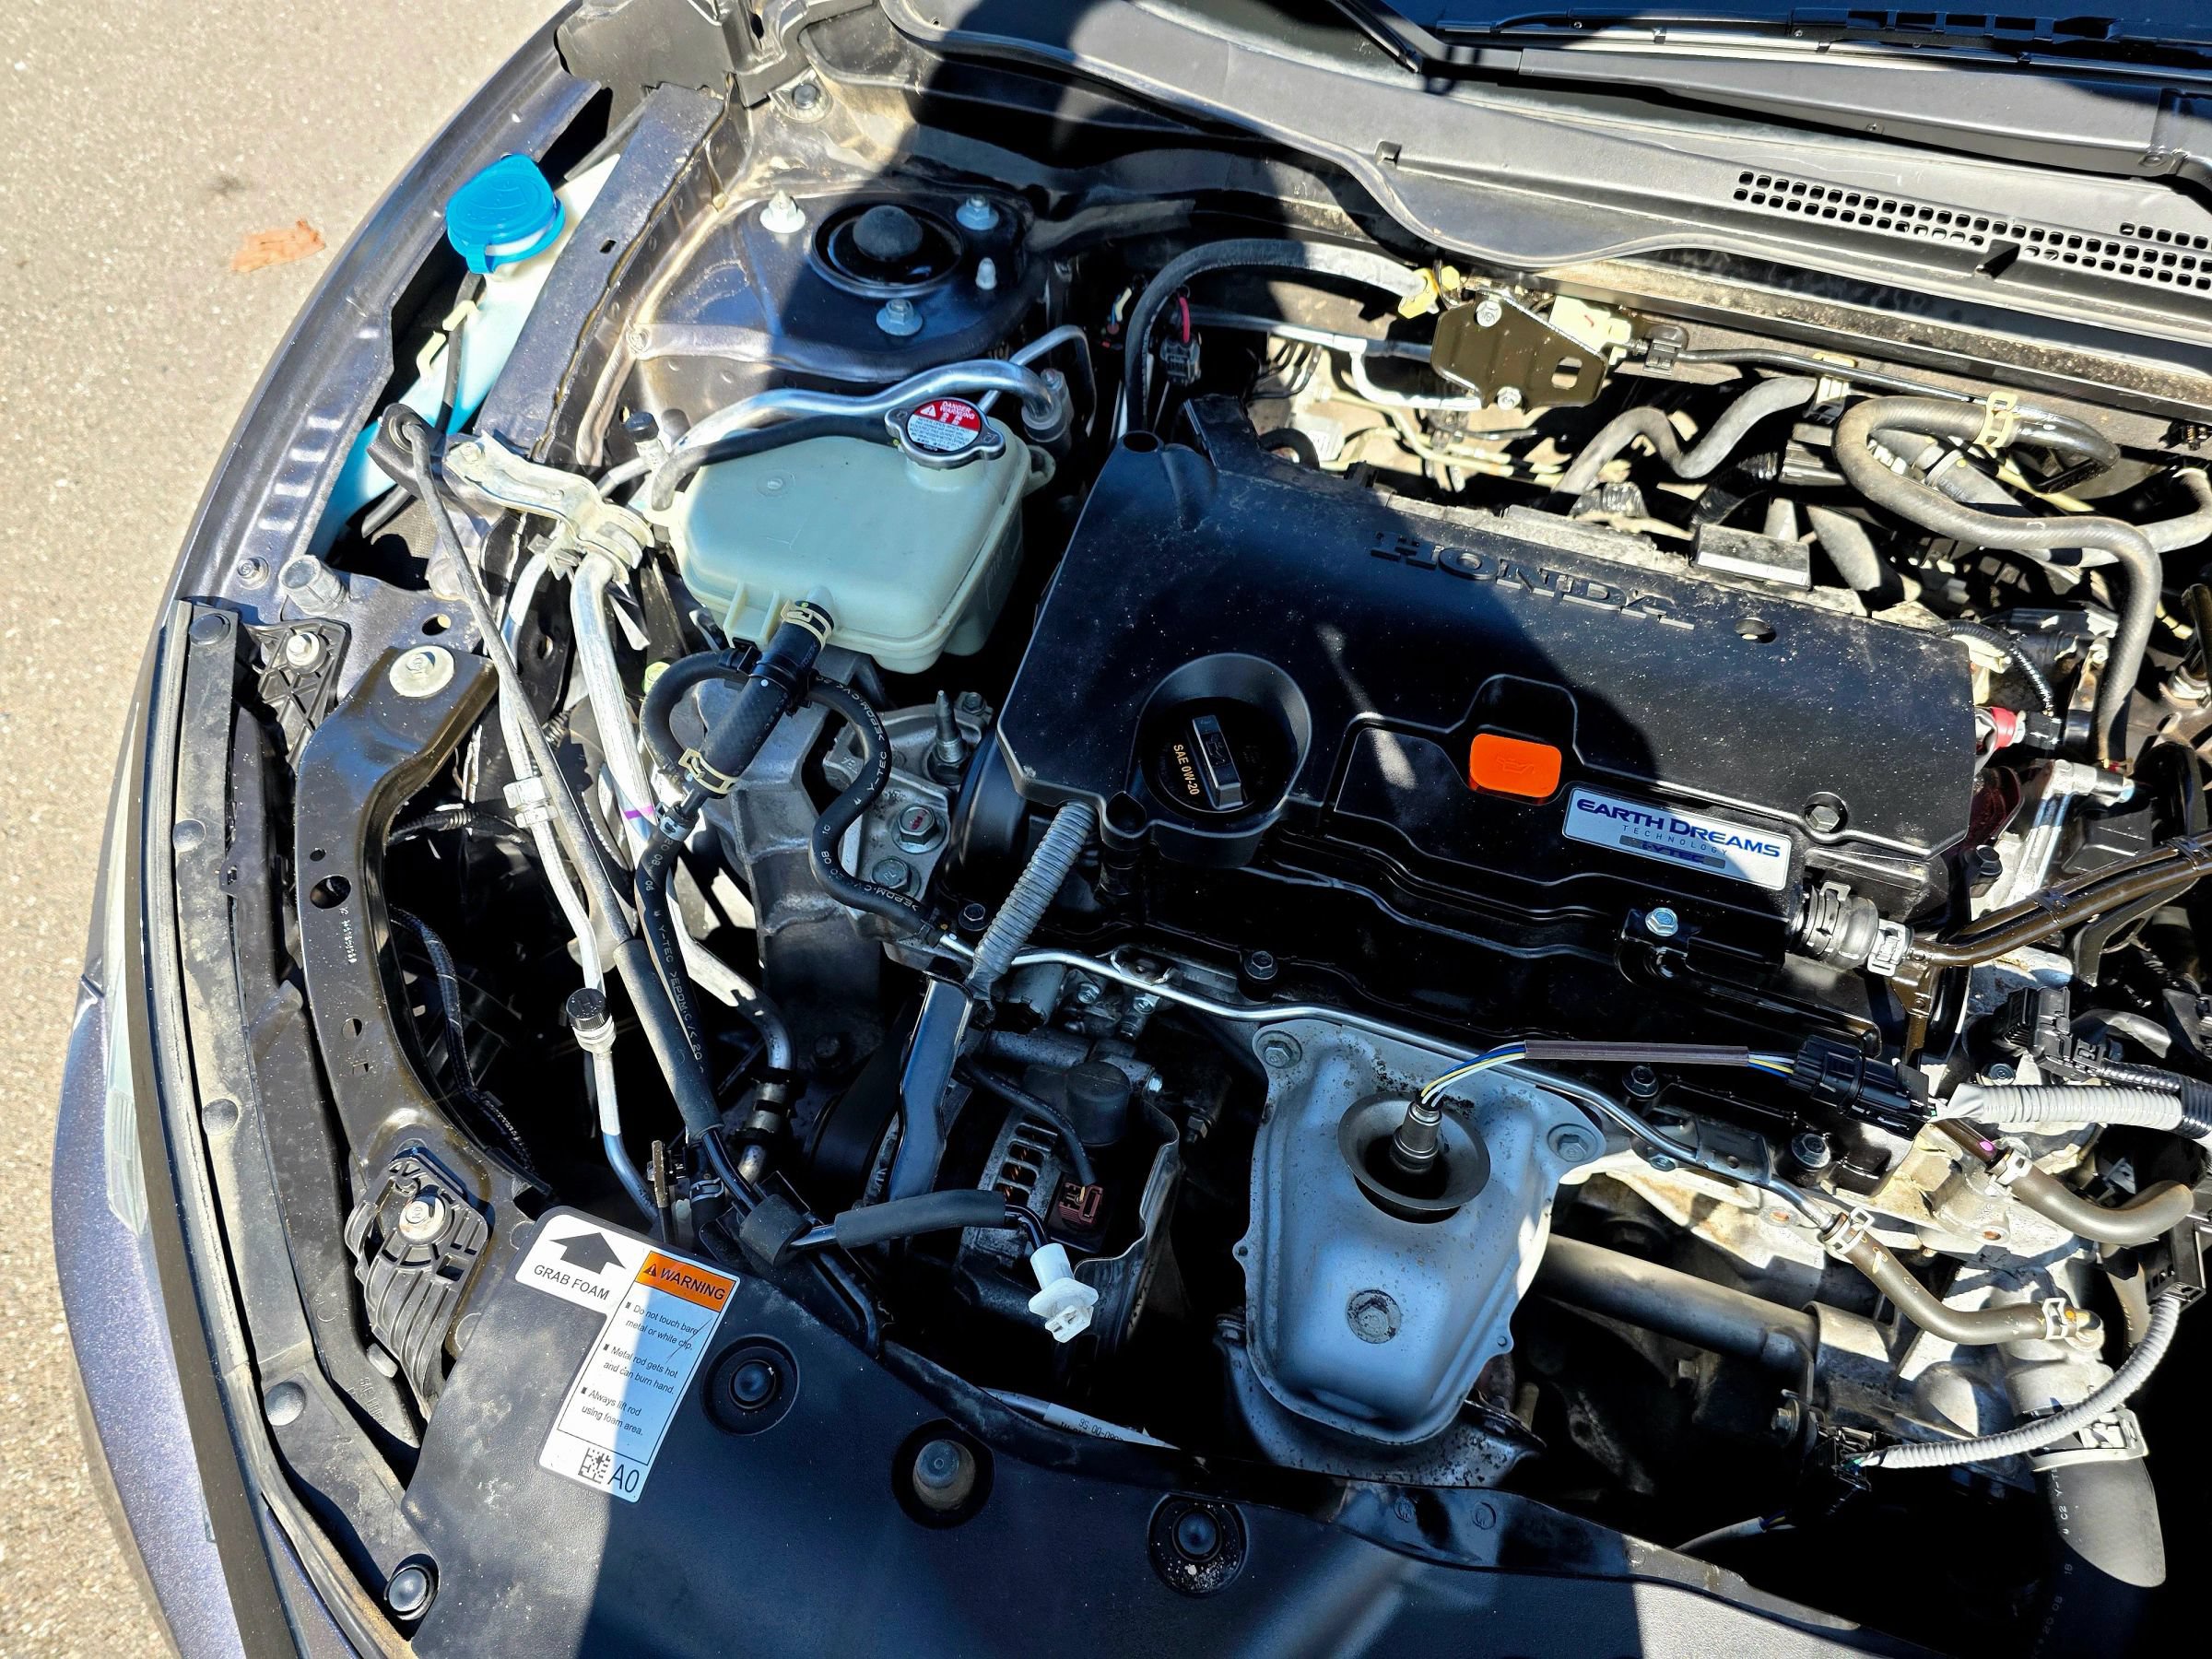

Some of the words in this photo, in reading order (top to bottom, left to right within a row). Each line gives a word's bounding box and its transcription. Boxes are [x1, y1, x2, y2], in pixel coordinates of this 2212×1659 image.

[1370, 530, 1695, 630] HONDA
[865, 751, 888, 791] Y-TEC
[1173, 744, 1189, 765] SAE
[1181, 766, 1200, 795] 0W-20
[1576, 798, 1665, 830] EARTH
[1669, 818, 1781, 858] DREAMS
[1622, 825, 1728, 856] TECHNOLOGY
[658, 924, 674, 963] Y-TEC
[534, 1264, 570, 1286] GRAB
[571, 1277, 610, 1300] FOAM
[660, 1266, 726, 1300] WARNING
[626, 1319, 648, 1333] metal
[648, 1327, 657, 1336] or
[657, 1330, 677, 1344] white
[678, 1337, 693, 1350] clip.
[632, 1304, 645, 1315] Do
[645, 1310, 658, 1321] not
[659, 1314, 680, 1328] touch
[680, 1323, 699, 1335] bare
[603, 1361, 620, 1372] and
[619, 1368, 634, 1379] can
[634, 1372, 653, 1386] burn
[653, 1381, 674, 1394] hand.
[610, 1346, 633, 1360] Metal
[632, 1355, 647, 1366] rod
[646, 1360, 664, 1373] gets
[665, 1367, 678, 1379] hot
[588, 1389, 616, 1406] Always
[617, 1400, 628, 1411] lift
[627, 1406, 642, 1417] rod
[581, 1406, 604, 1420] using
[603, 1412, 623, 1428] foam
[623, 1423, 643, 1435] area.
[2050, 1466, 2064, 1498] Y-TE
